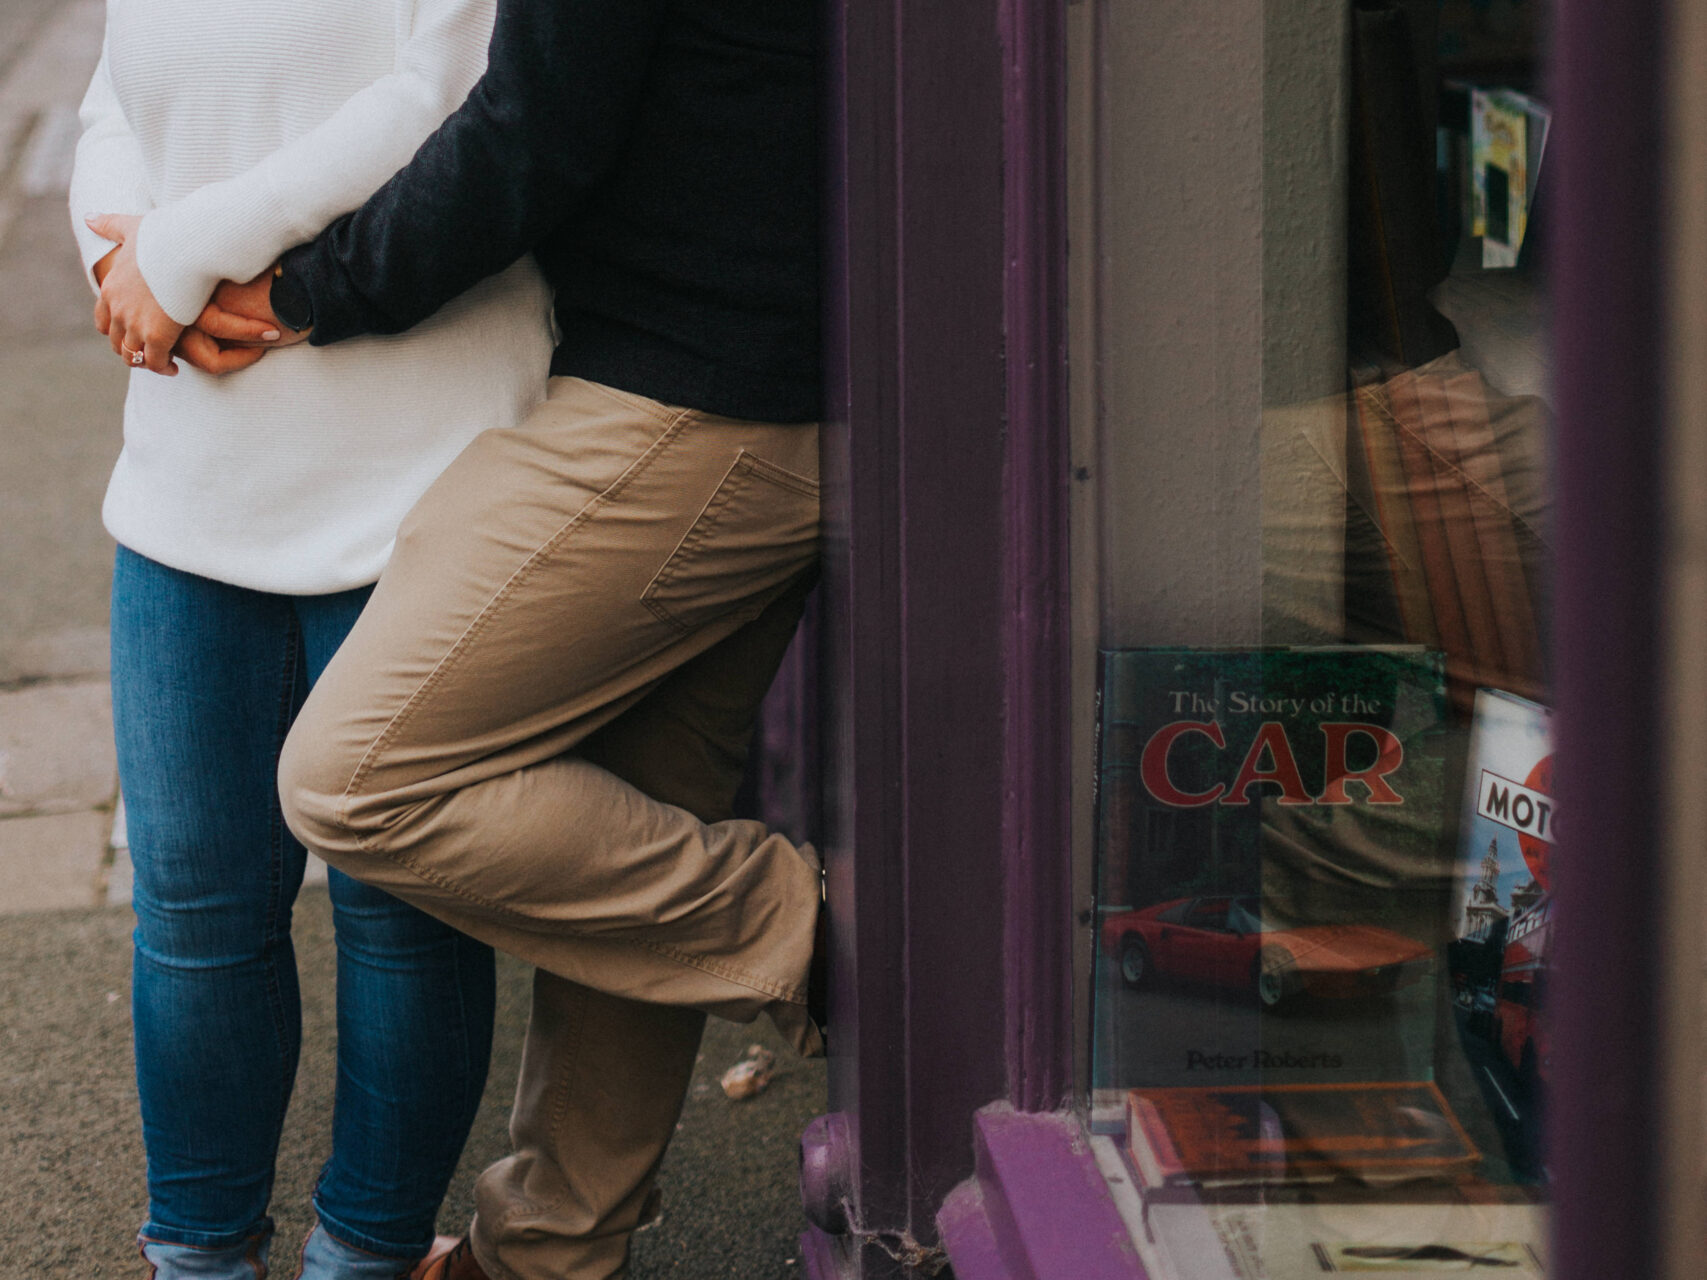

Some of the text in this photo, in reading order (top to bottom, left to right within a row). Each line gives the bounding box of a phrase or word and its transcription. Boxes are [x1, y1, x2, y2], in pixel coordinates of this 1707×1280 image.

[1169, 691, 1381, 718] The Story of the
[1140, 721, 1404, 807] CAR
[1187, 1050, 1343, 1069] Peter Roberts
